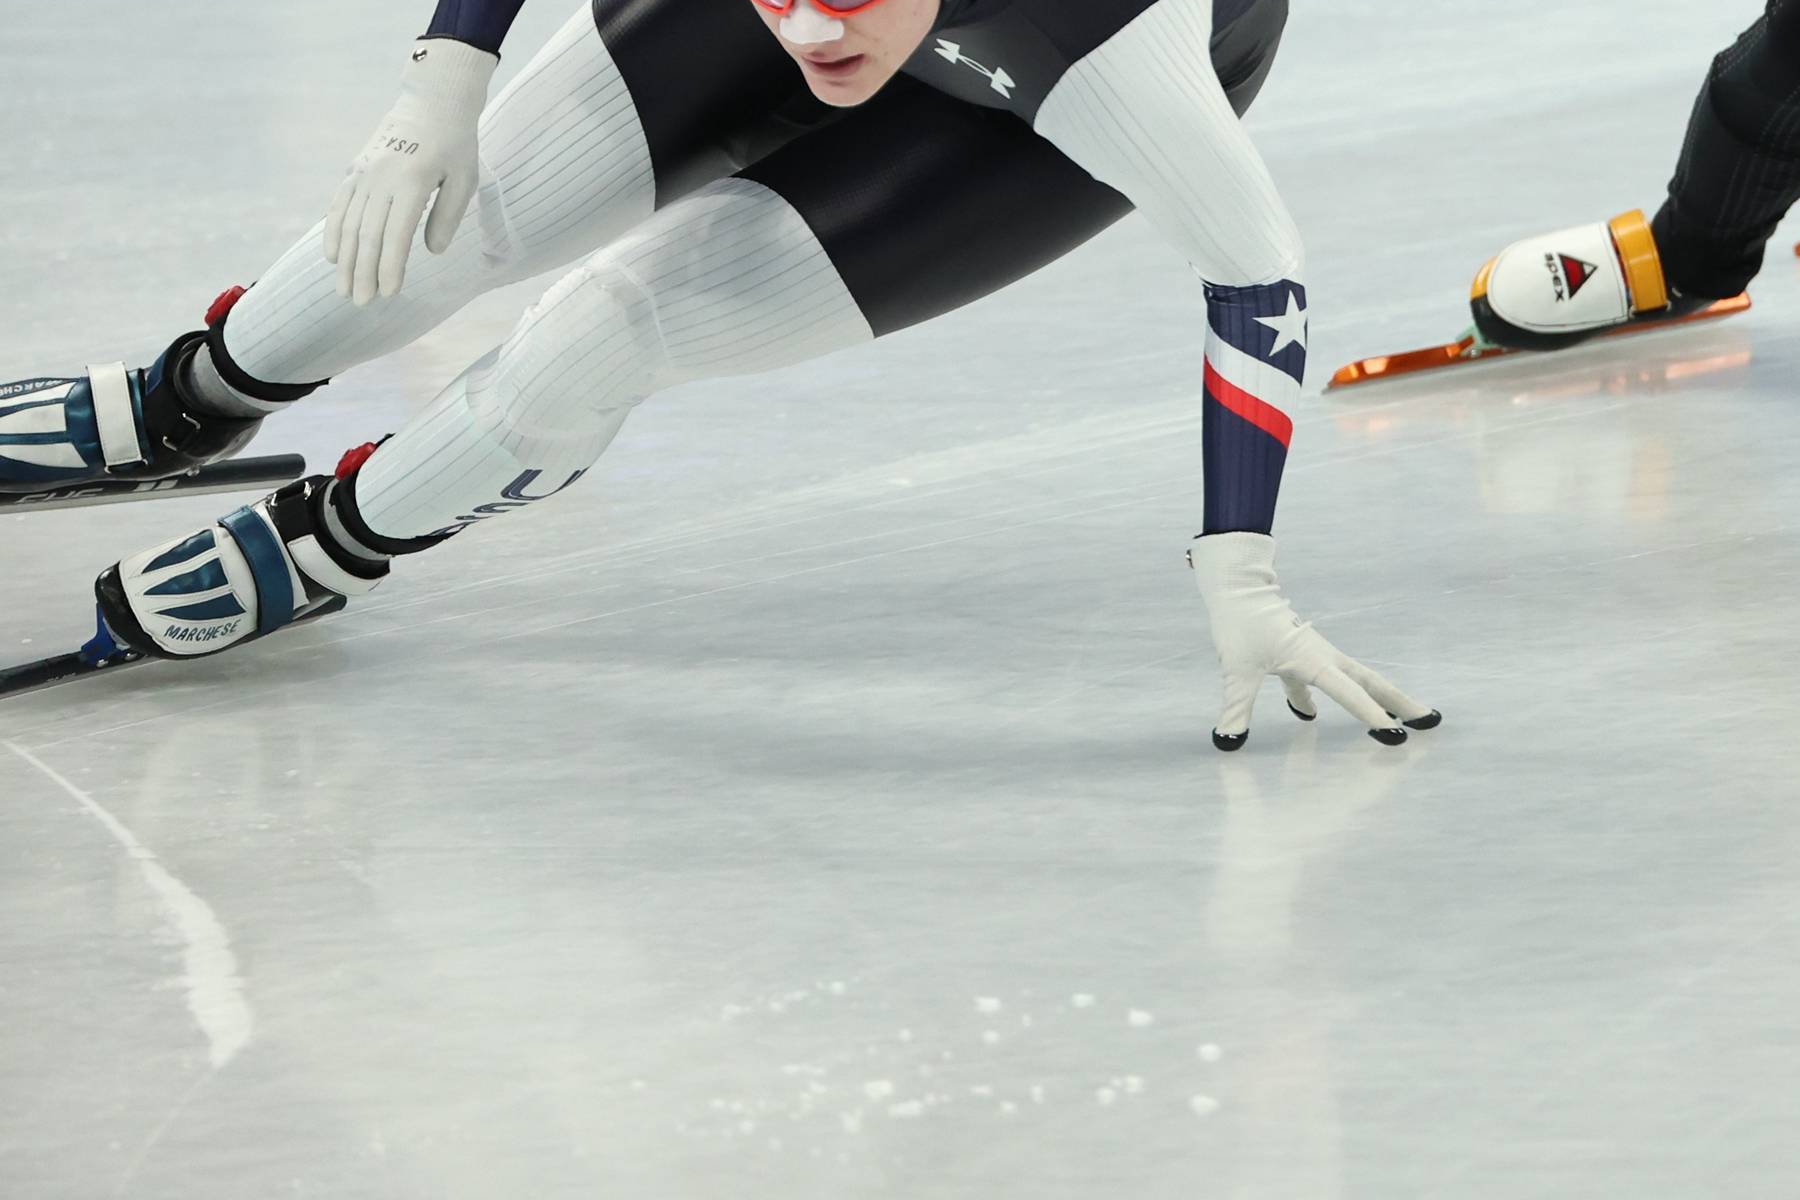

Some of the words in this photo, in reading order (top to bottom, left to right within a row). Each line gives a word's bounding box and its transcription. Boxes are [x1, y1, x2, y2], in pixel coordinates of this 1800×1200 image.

[385, 137, 420, 155] USA
[1544, 253, 1565, 303] apex
[163, 618, 242, 643] MARCHESE
